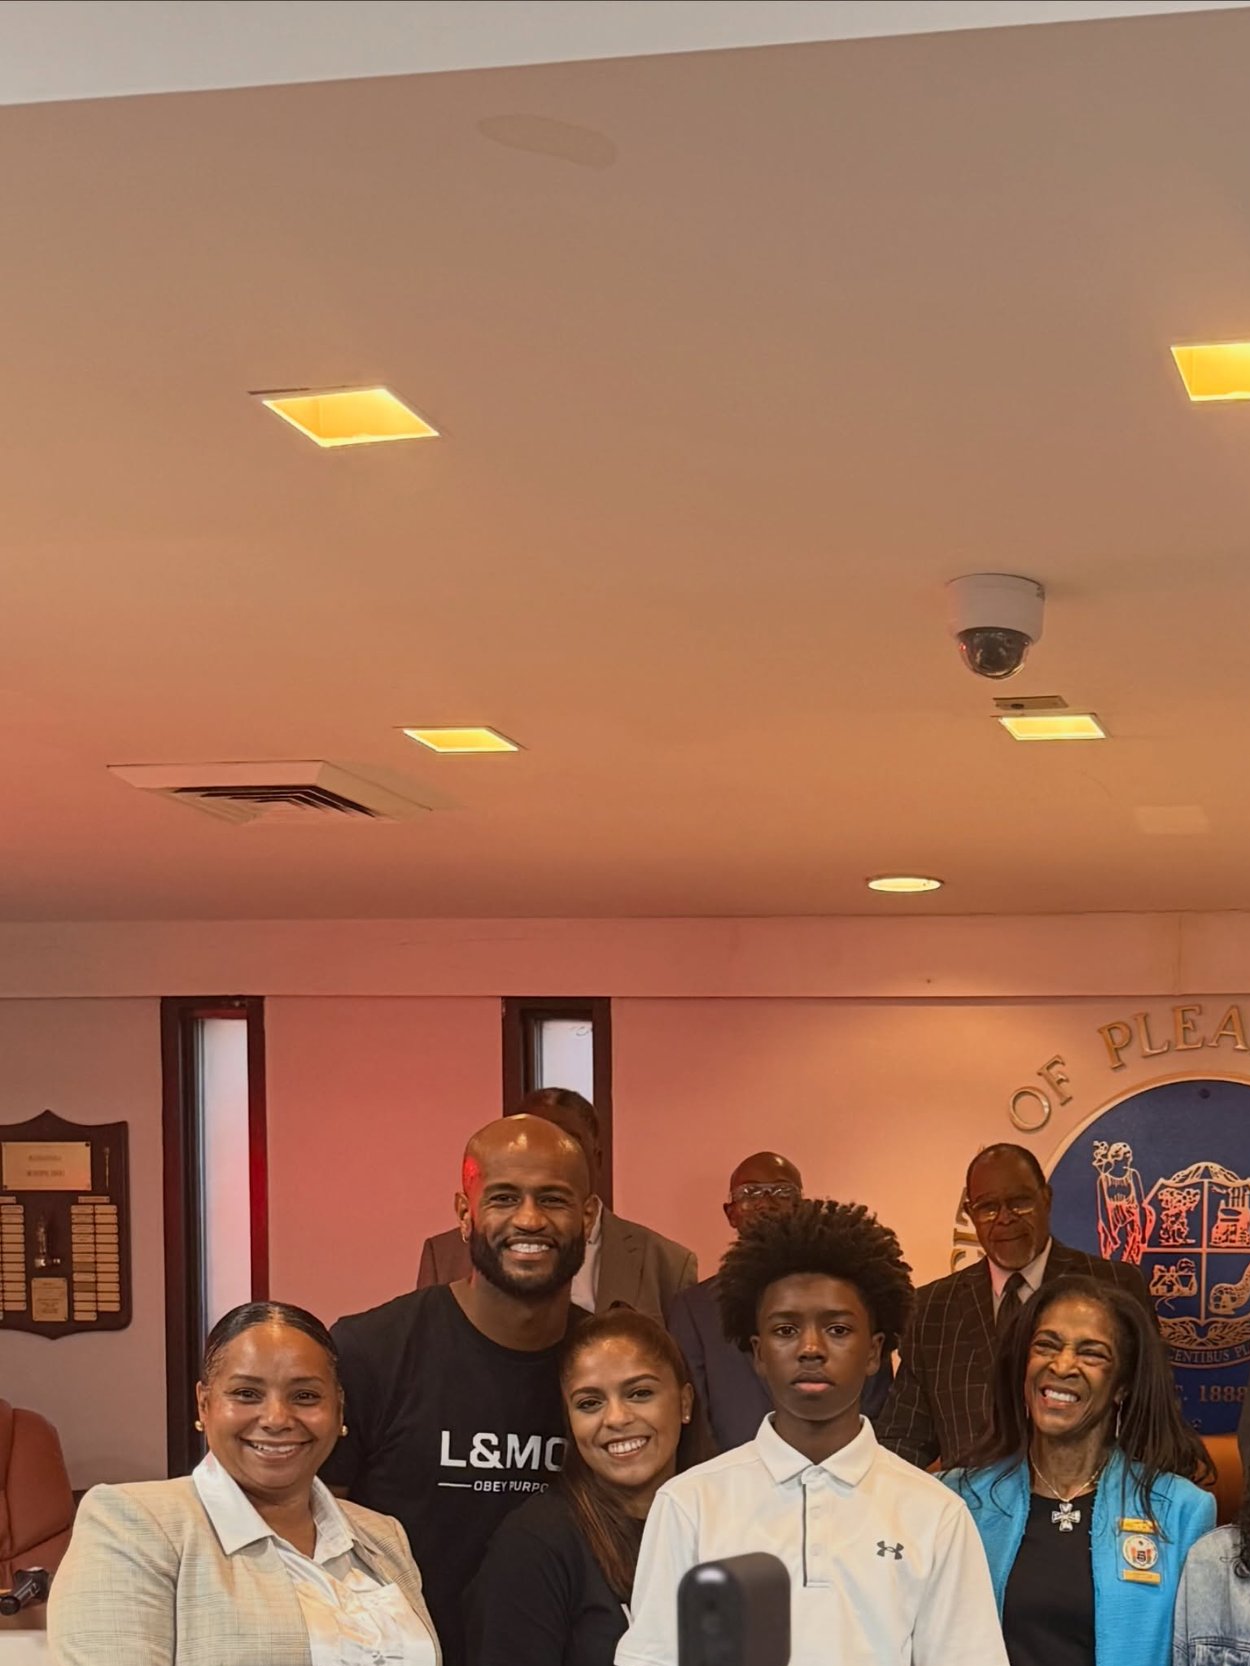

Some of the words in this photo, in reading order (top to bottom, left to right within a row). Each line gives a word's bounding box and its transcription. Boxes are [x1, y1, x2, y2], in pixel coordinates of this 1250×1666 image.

[1008, 1055, 1072, 1133] OF
[1200, 1384, 1247, 1402] 1888
[473, 1479, 507, 1493] OBEY
